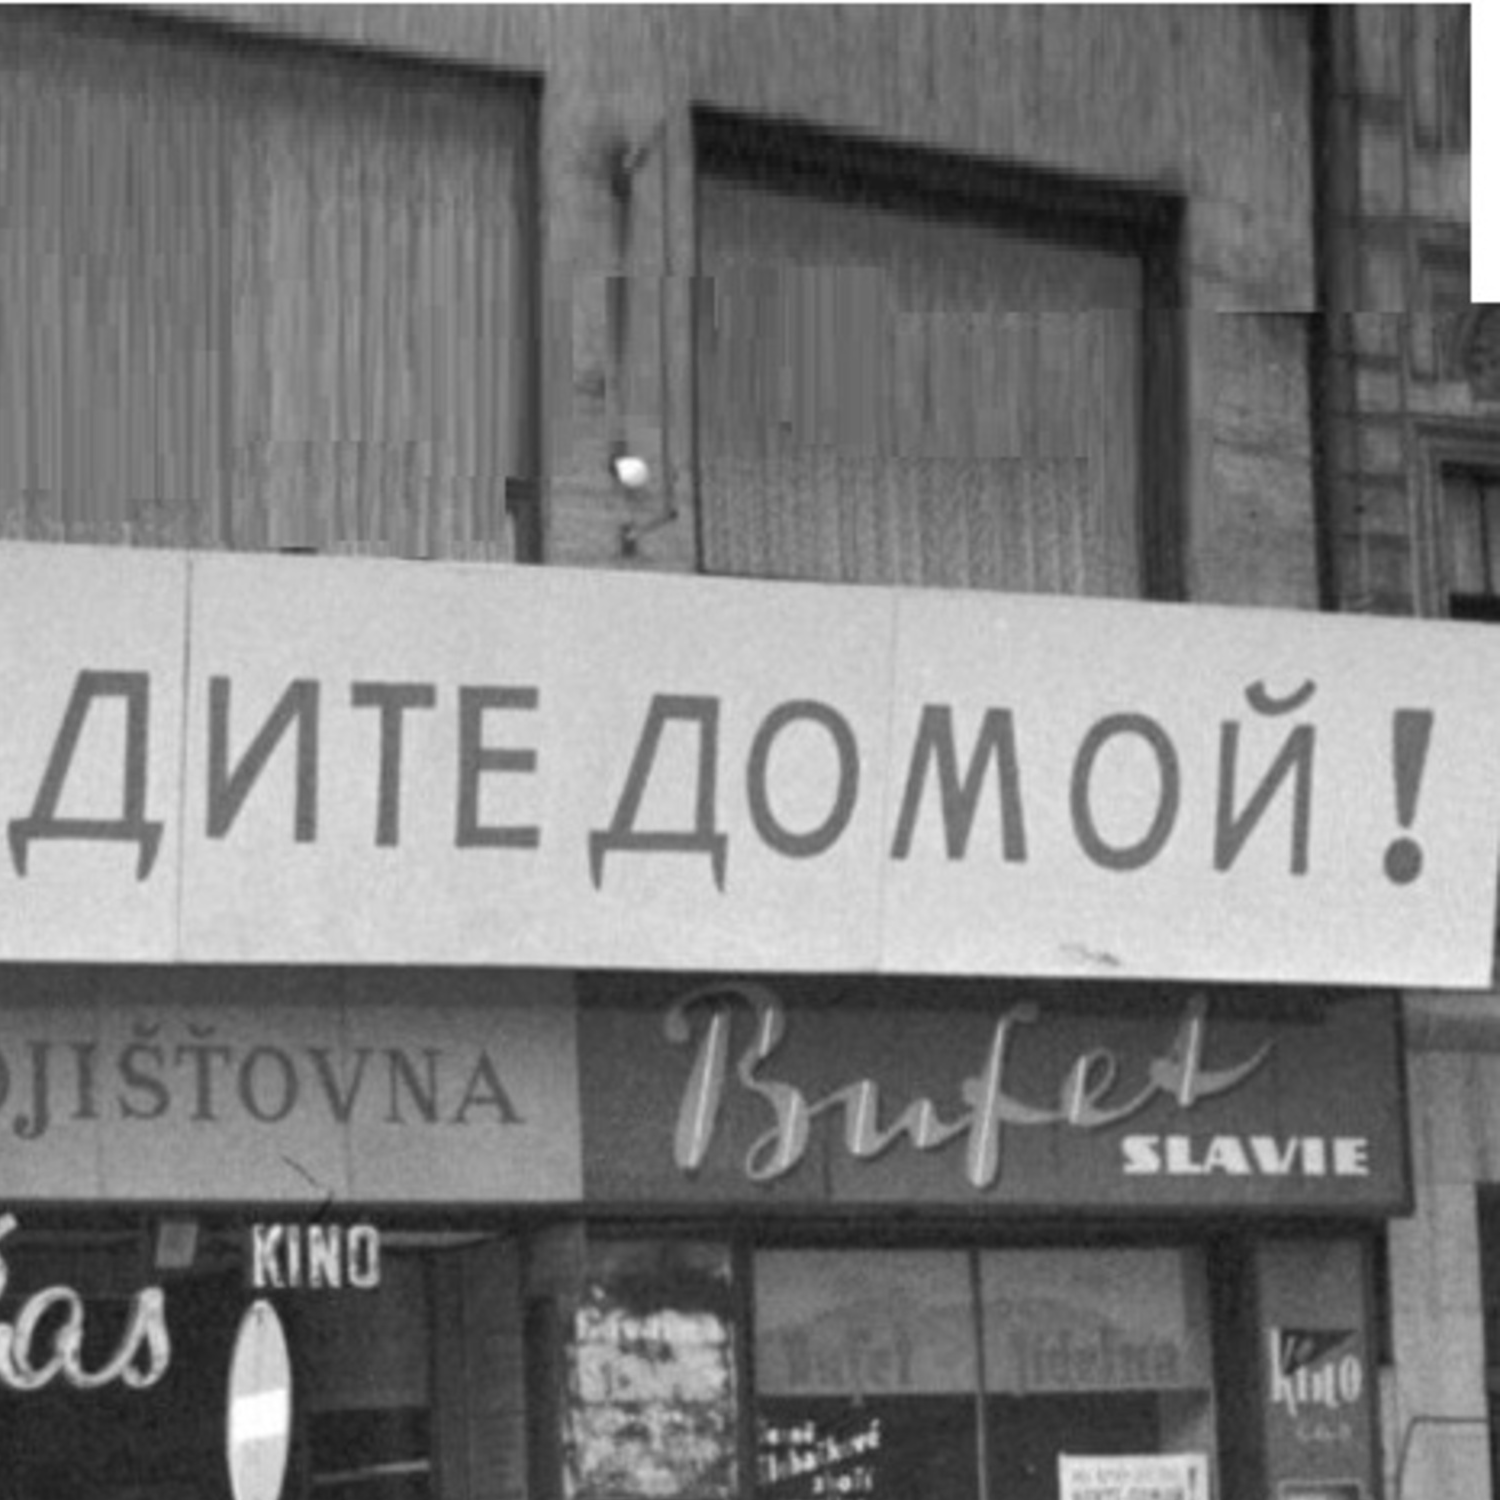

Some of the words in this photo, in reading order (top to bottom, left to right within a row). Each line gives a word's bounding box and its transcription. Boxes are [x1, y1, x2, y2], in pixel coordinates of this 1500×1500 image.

[663, 980, 1276, 1187] Bufet
[1121, 1134, 1369, 1177] SLAVIE
[250, 1222, 382, 1290] KINO
